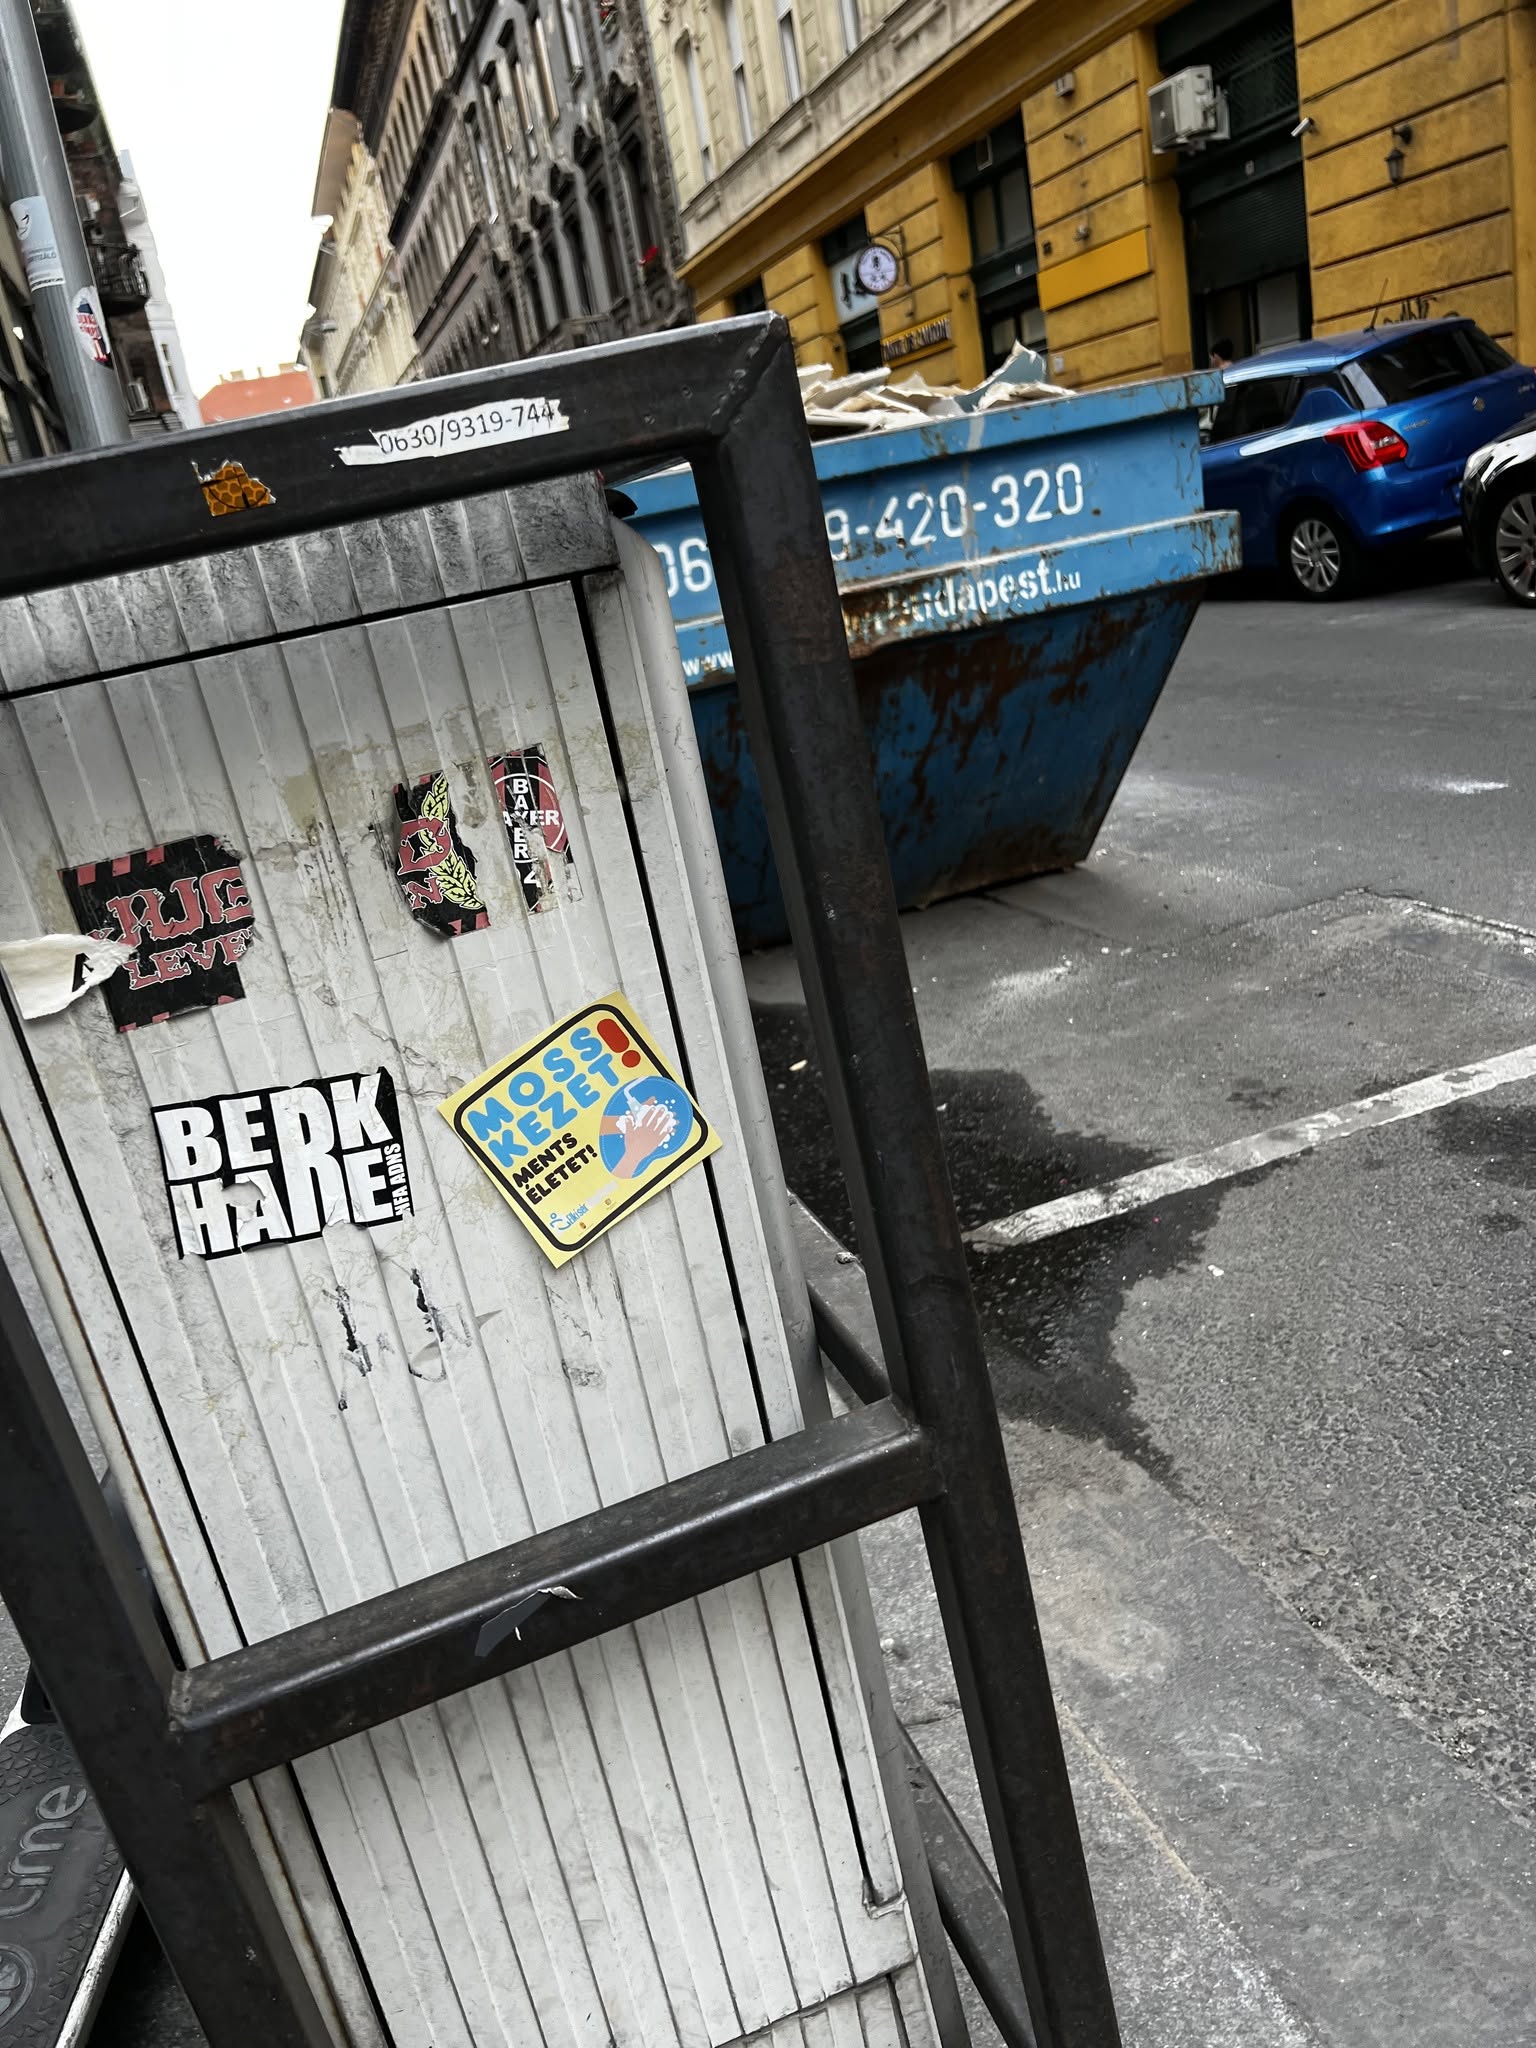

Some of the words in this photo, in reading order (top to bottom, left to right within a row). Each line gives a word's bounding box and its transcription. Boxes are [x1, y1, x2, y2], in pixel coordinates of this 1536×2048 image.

[378, 403, 555, 455] 0630/9319-744
[512, 1132, 578, 1189] MENTS
[524, 1144, 598, 1205] ÉLETET!
